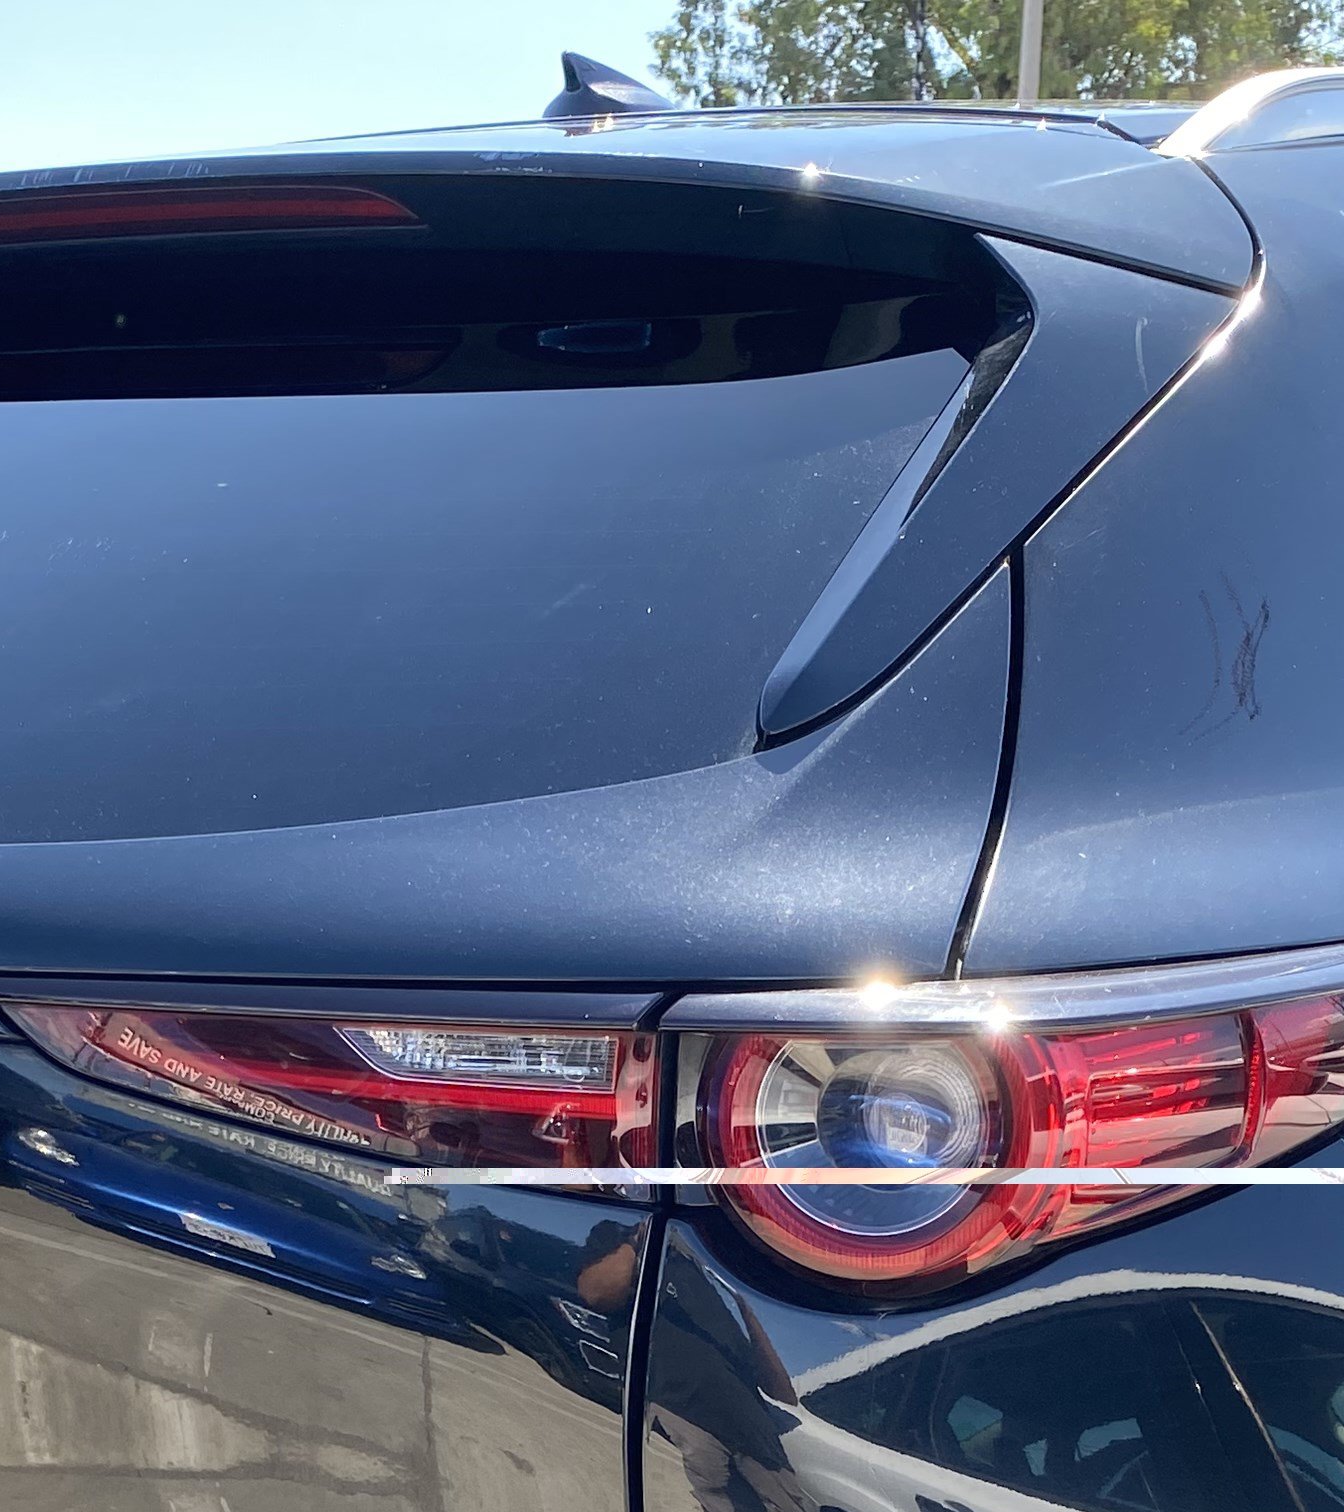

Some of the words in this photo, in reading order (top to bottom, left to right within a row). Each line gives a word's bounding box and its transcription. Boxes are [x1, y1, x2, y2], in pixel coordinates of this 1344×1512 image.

[117, 1026, 164, 1064] SAVE
[162, 1057, 204, 1083] AND
[203, 1075, 246, 1100] RATE
